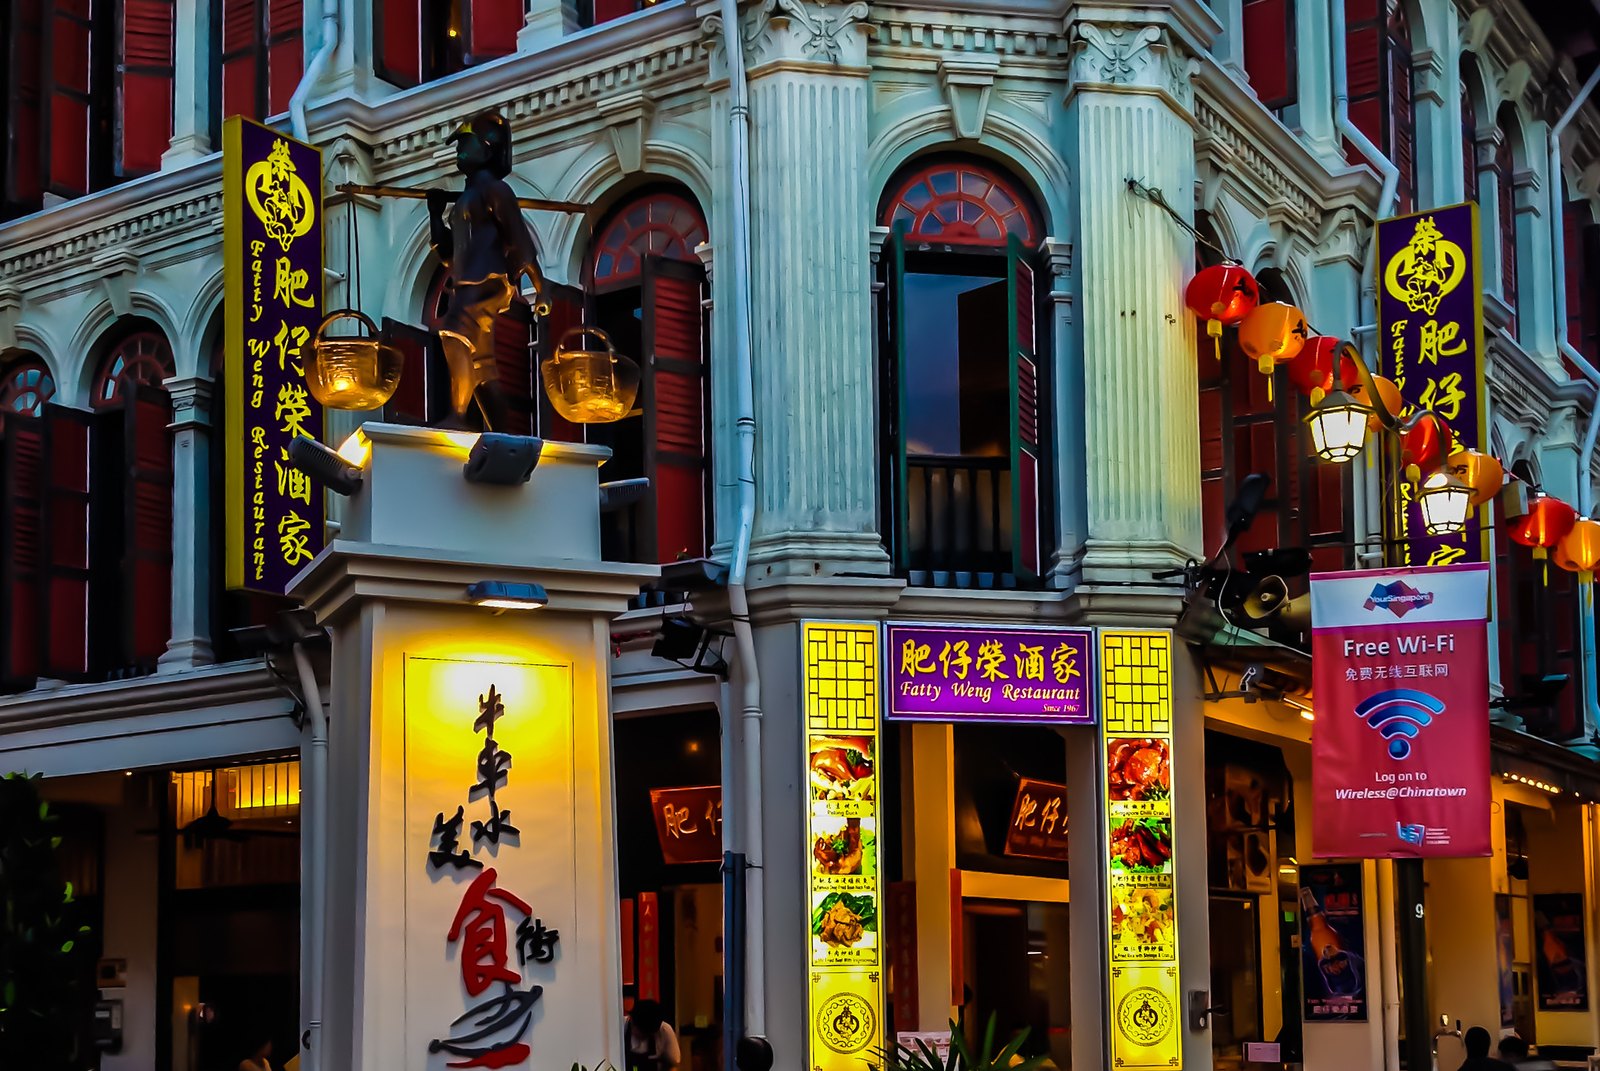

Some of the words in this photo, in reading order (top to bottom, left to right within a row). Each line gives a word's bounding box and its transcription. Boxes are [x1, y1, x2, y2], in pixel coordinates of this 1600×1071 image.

[250, 240, 265, 322] Fatty
[248, 338, 270, 408] Weng
[251, 426, 269, 581] Restaurant
[1369, 594, 1431, 603] YourSingapore
[1344, 640, 1390, 657] Free
[1397, 634, 1454, 654] Wi-Fi
[1345, 664, 1448, 681] 免费无线互联网
[900, 681, 941, 702] Fatty
[951, 682, 992, 703] Weng
[1002, 684, 1080, 702] Restaurant
[1042, 703, 1060, 713] Since
[1063, 704, 1080, 712] 1967
[1375, 772, 1395, 783] Log
[1398, 772, 1412, 781] on
[1415, 772, 1427, 780] to
[1335, 787, 1467, 800] Wireless@Chinatown
